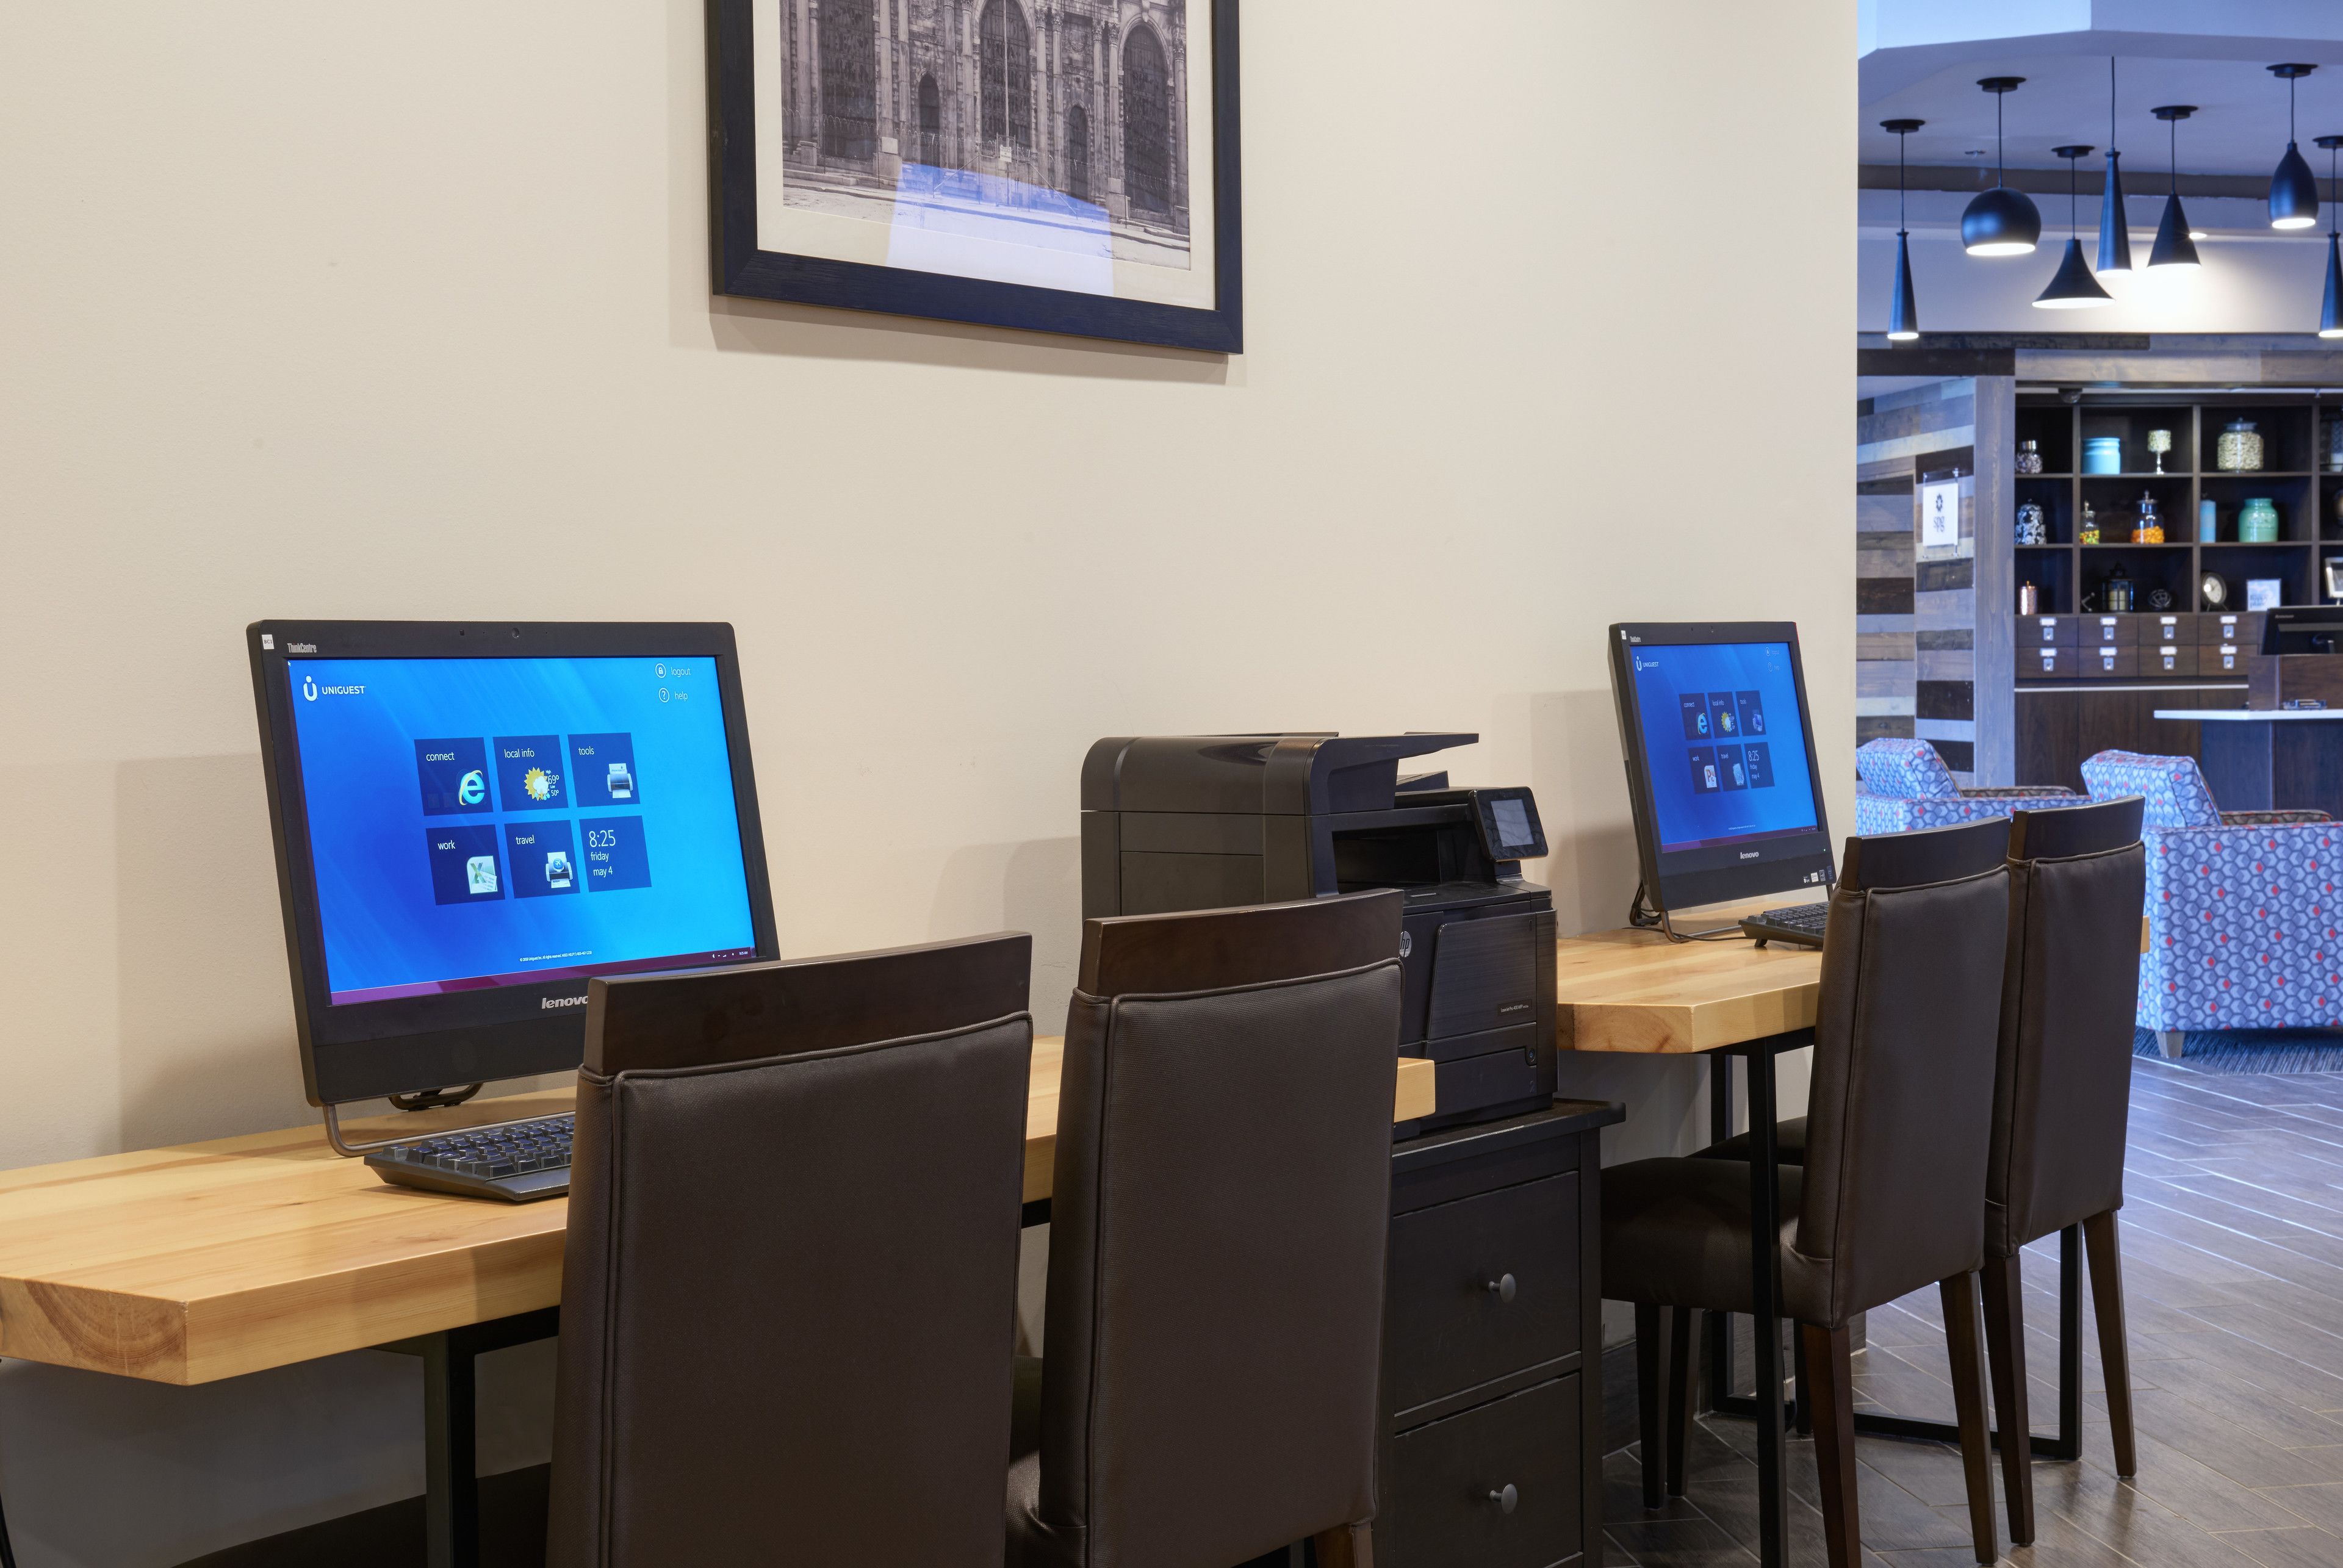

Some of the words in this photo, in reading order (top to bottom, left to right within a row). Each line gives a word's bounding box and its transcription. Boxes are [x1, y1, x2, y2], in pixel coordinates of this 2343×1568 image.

[1933, 516, 1945, 532] spg
[287, 642, 317, 653] ThinkCentre
[671, 667, 691, 677] logout
[322, 685, 365, 695] UNIGUEST
[674, 691, 688, 702] help
[504, 748, 520, 758] local
[521, 748, 534, 758] info
[578, 746, 595, 755] tools
[1747, 750, 1760, 761] 8:25
[426, 752, 455, 761] connect
[515, 834, 535, 845] travel
[589, 830, 616, 847] 8:25
[437, 840, 456, 850] work
[590, 851, 609, 863] friday
[593, 868, 607, 878] may
[608, 866, 613, 875] 4
